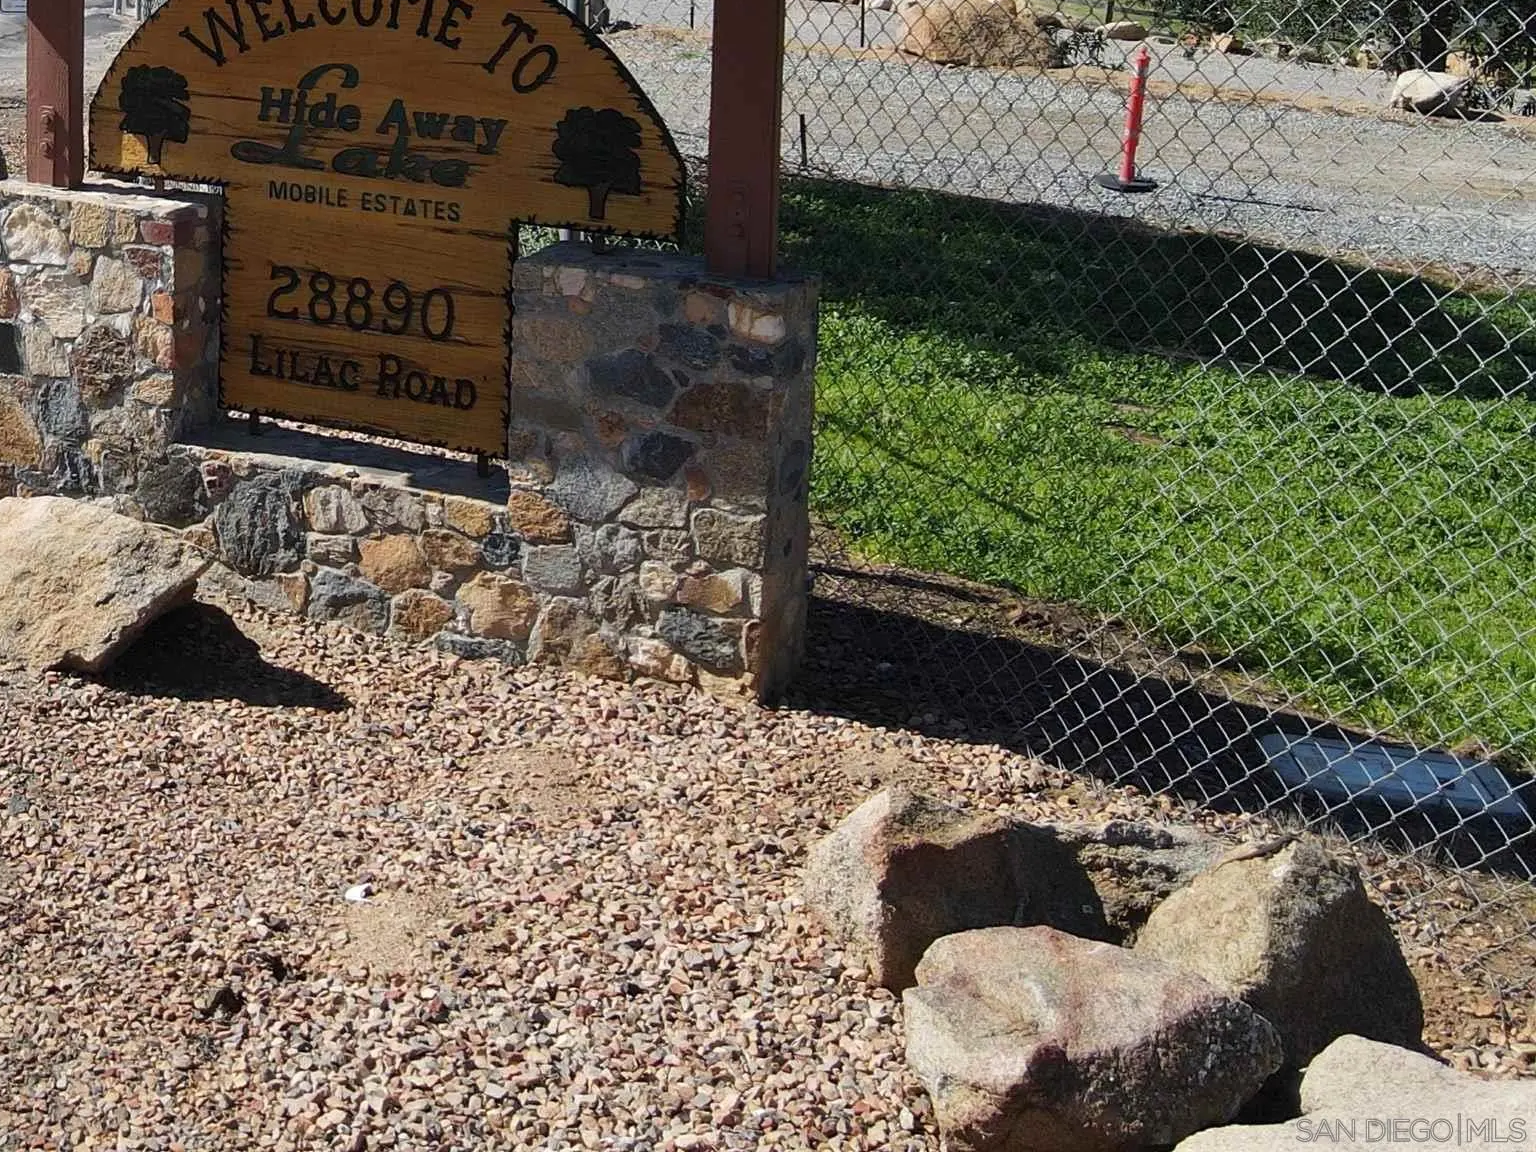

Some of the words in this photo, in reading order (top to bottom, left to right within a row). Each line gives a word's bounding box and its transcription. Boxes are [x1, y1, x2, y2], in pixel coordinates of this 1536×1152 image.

[481, 12, 559, 94] TO
[257, 86, 362, 132] Hide
[375, 98, 509, 155] Away
[268, 180, 349, 208] MOBILE
[361, 191, 462, 222] ESTATES
[267, 264, 456, 341] 28890
